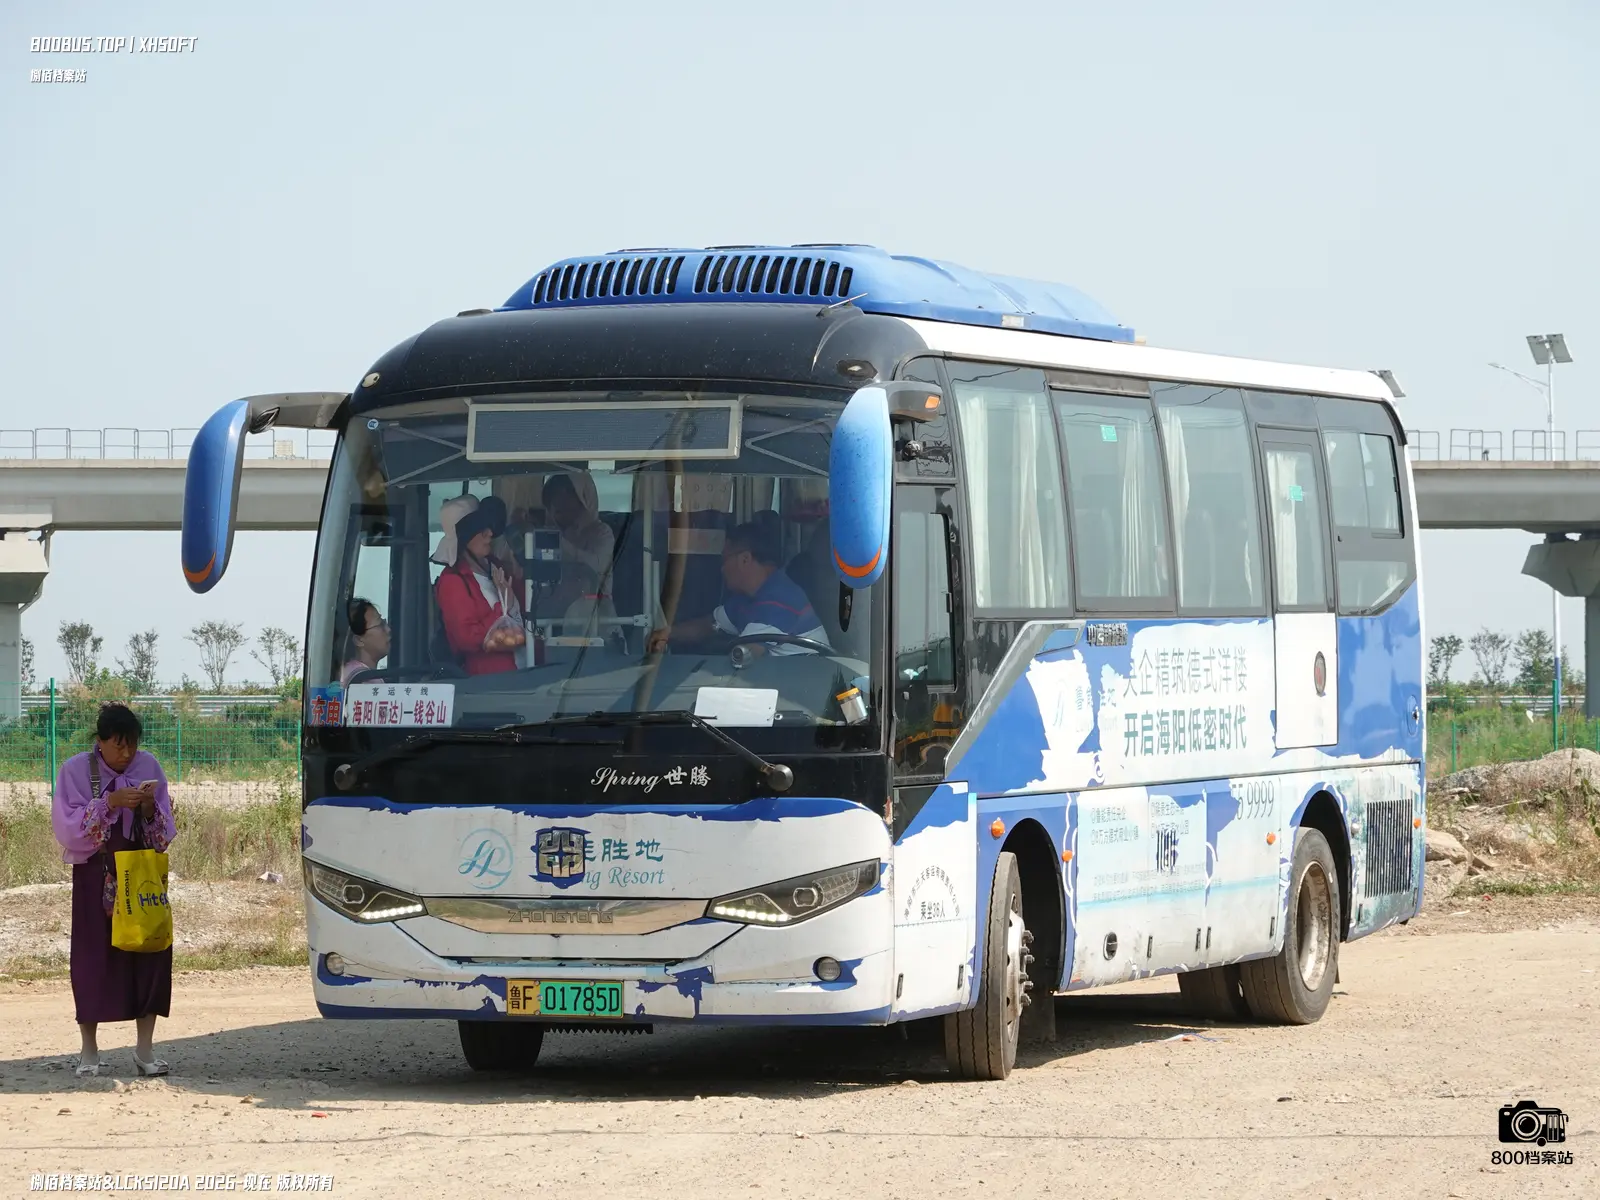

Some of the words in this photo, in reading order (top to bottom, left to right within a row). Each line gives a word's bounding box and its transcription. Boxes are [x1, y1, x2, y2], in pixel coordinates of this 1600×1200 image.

[372, 687, 429, 696] 客运专线
[1123, 704, 1247, 758] 开启海阳低密时代
[590, 767, 663, 793] Spring
[1247, 780, 1275, 820] 9999
[608, 866, 665, 885] Resort
[508, 910, 613, 924] ZHONGTONG
[509, 985, 534, 1010] 鲁F
[544, 986, 620, 1012] 01785D
